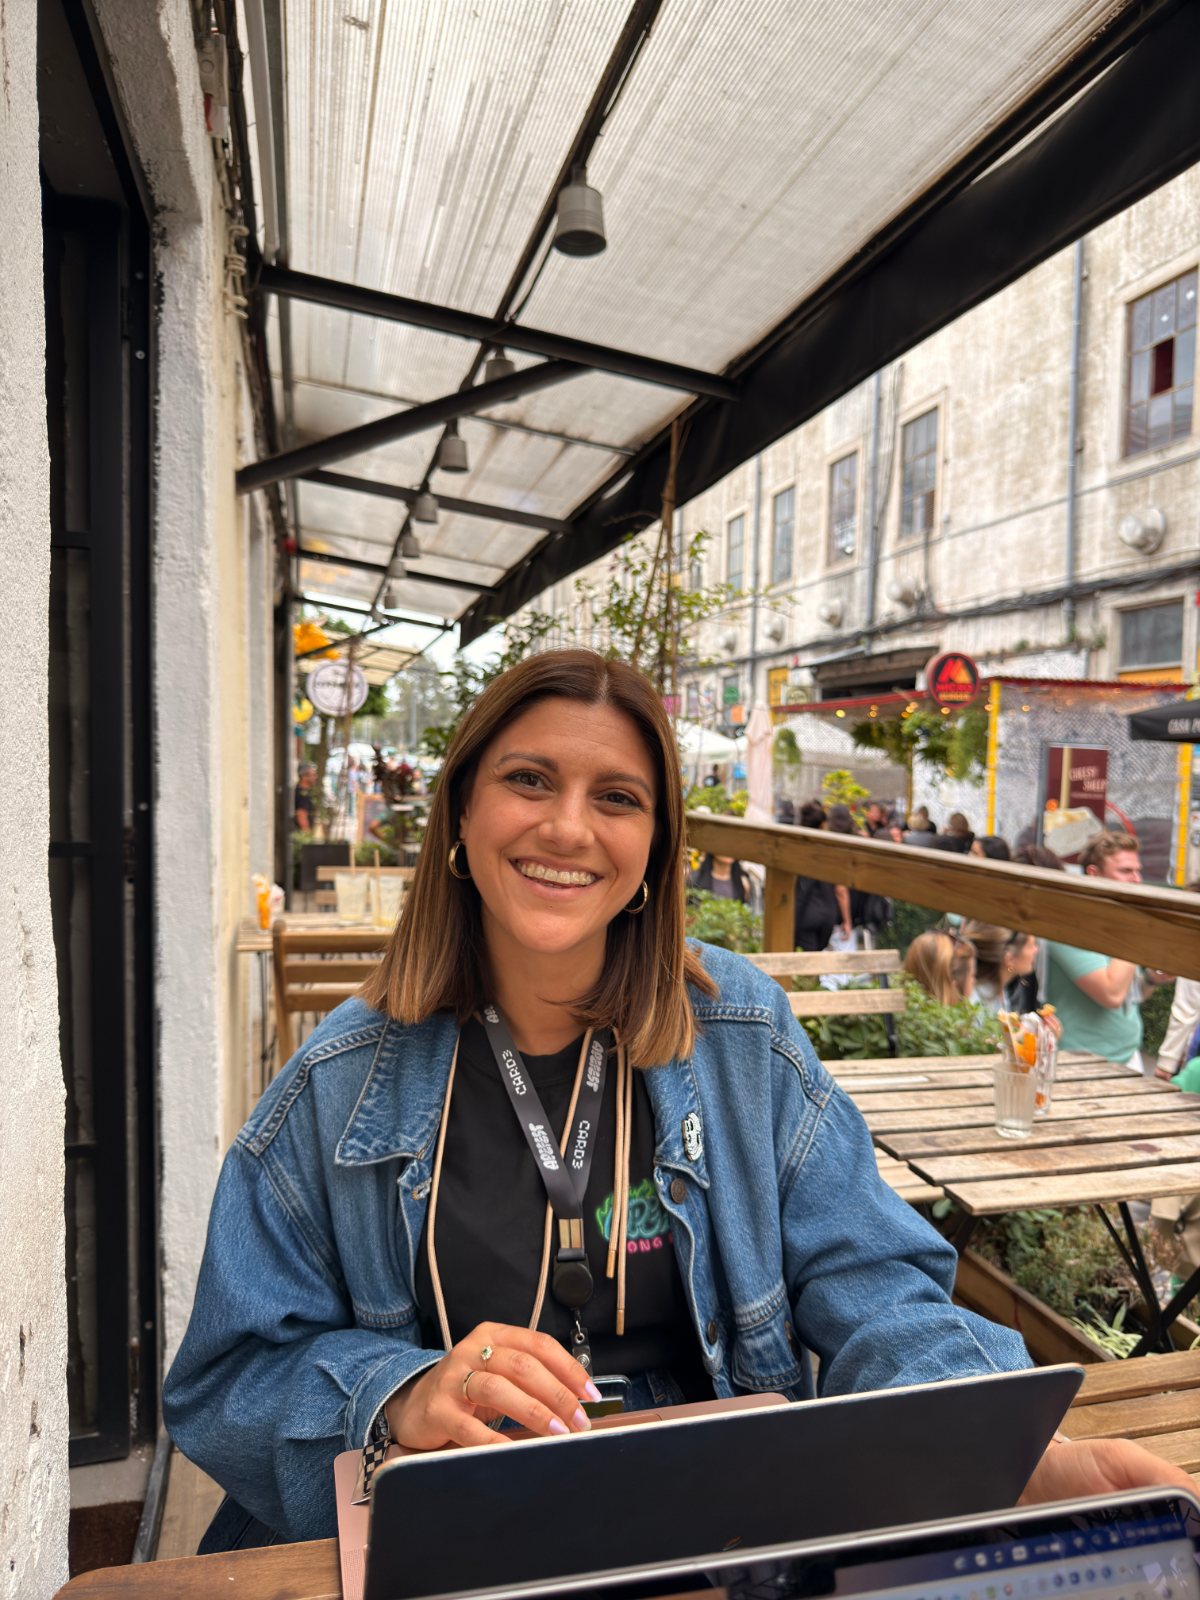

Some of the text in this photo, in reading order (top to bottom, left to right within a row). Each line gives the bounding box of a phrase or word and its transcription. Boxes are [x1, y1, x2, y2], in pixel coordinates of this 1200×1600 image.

[502, 1049, 527, 1095] CARD3
[571, 1119, 591, 1170] CARD3
[626, 1236, 663, 1254] ONG
